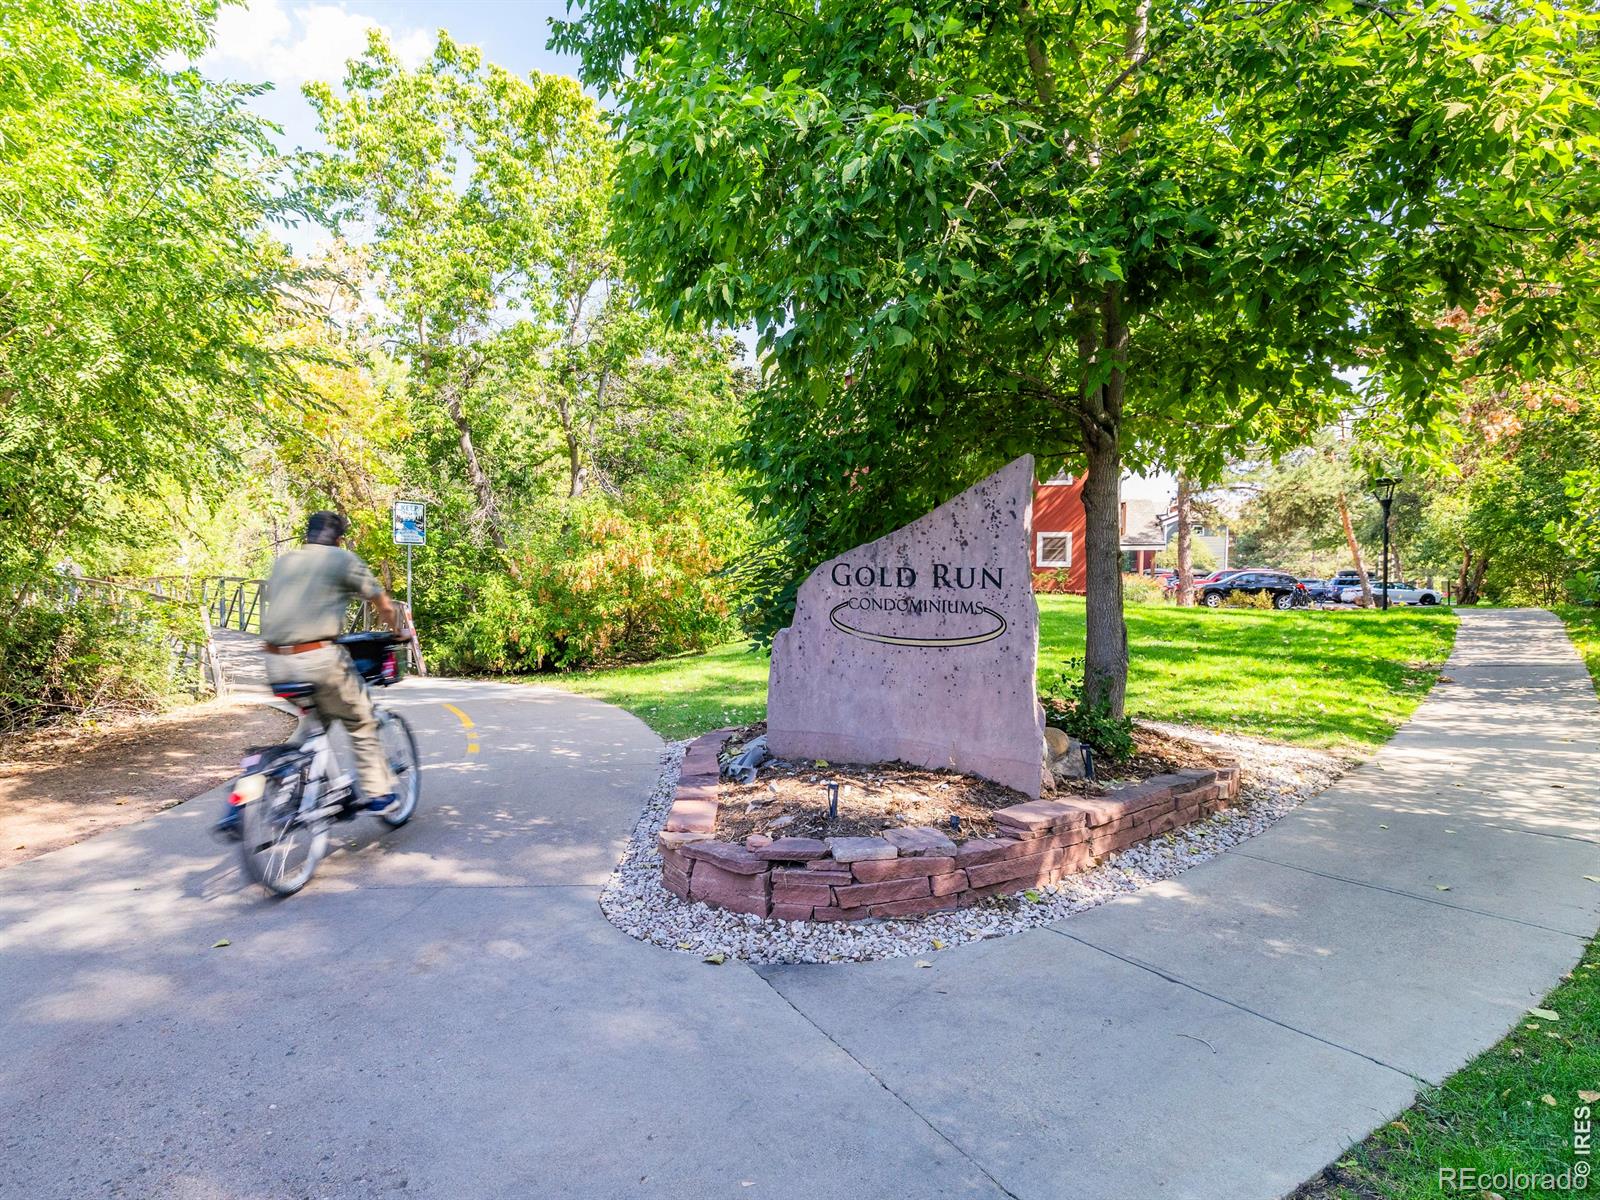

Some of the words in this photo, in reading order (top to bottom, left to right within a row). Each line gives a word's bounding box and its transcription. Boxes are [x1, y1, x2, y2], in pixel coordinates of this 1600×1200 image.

[831, 563, 917, 588] GOLD
[933, 563, 1005, 590] RUN
[848, 597, 985, 615] CONDOMINIUMS
